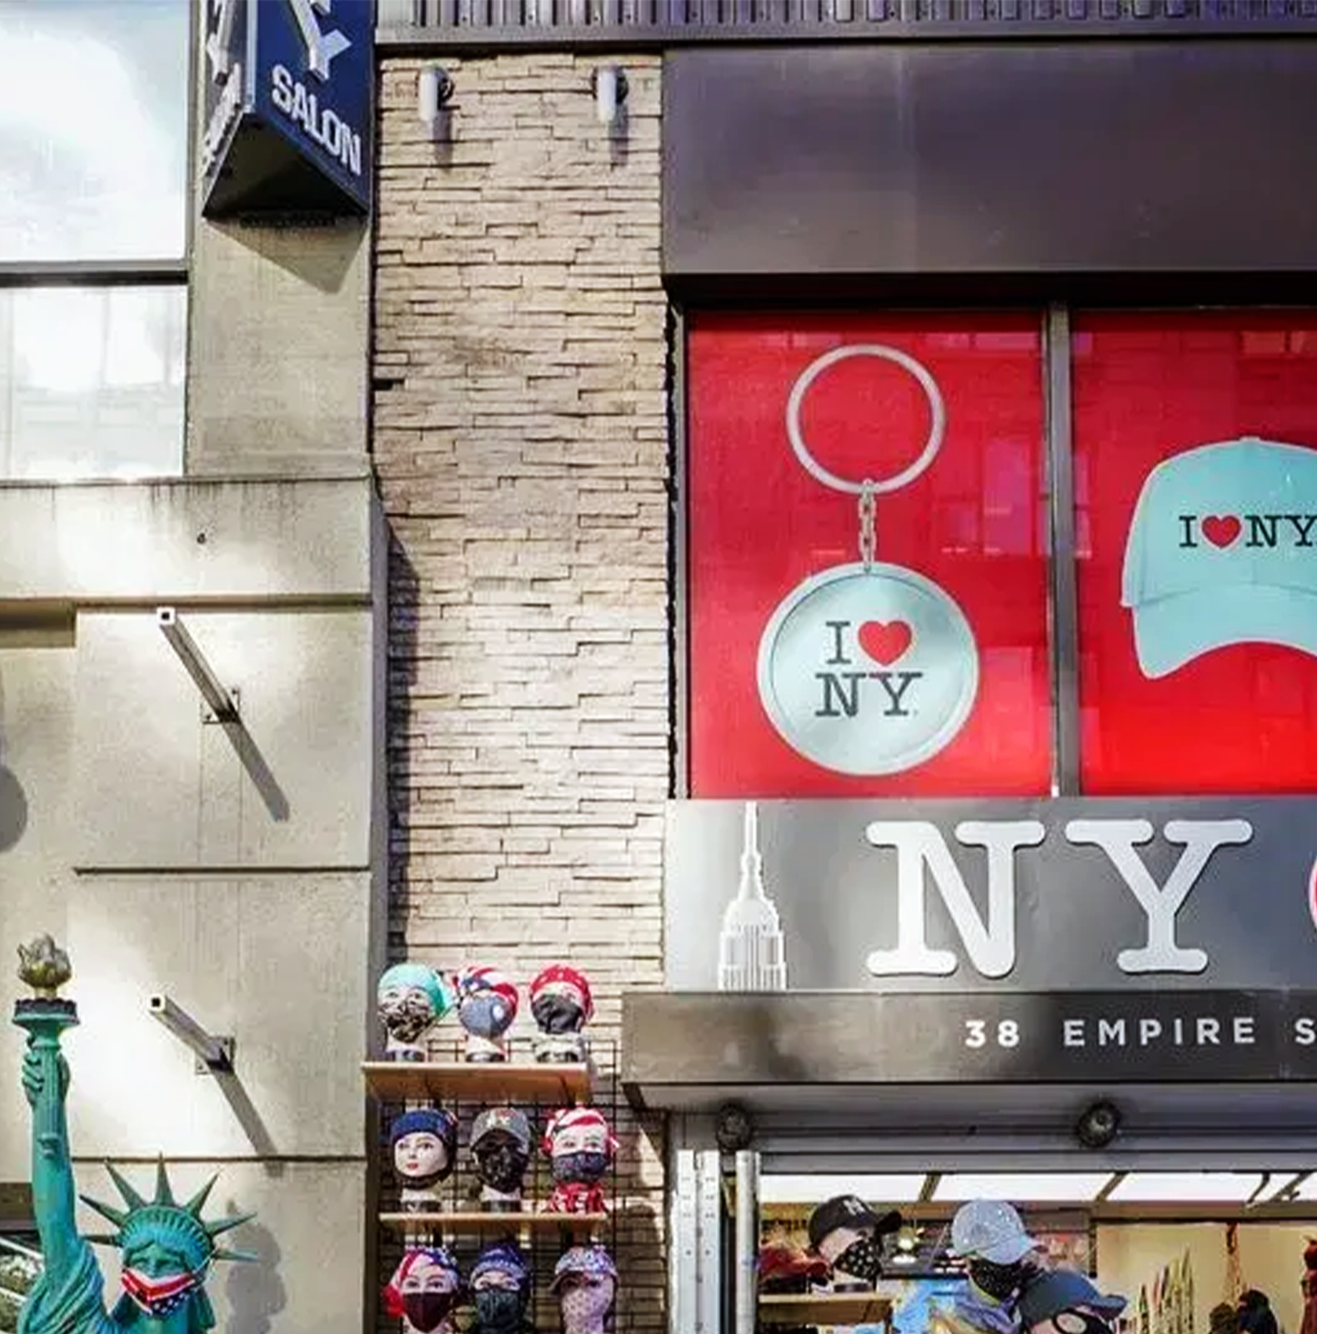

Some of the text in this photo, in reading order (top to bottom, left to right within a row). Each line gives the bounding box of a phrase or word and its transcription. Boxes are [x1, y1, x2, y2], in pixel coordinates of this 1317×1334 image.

[271, 64, 362, 176] SALON
[1180, 514, 1197, 549] I
[825, 620, 852, 665] I
[866, 818, 1253, 978] NY
[964, 1019, 1023, 1049] 38
[1063, 1017, 1258, 1048] EMPIRE
